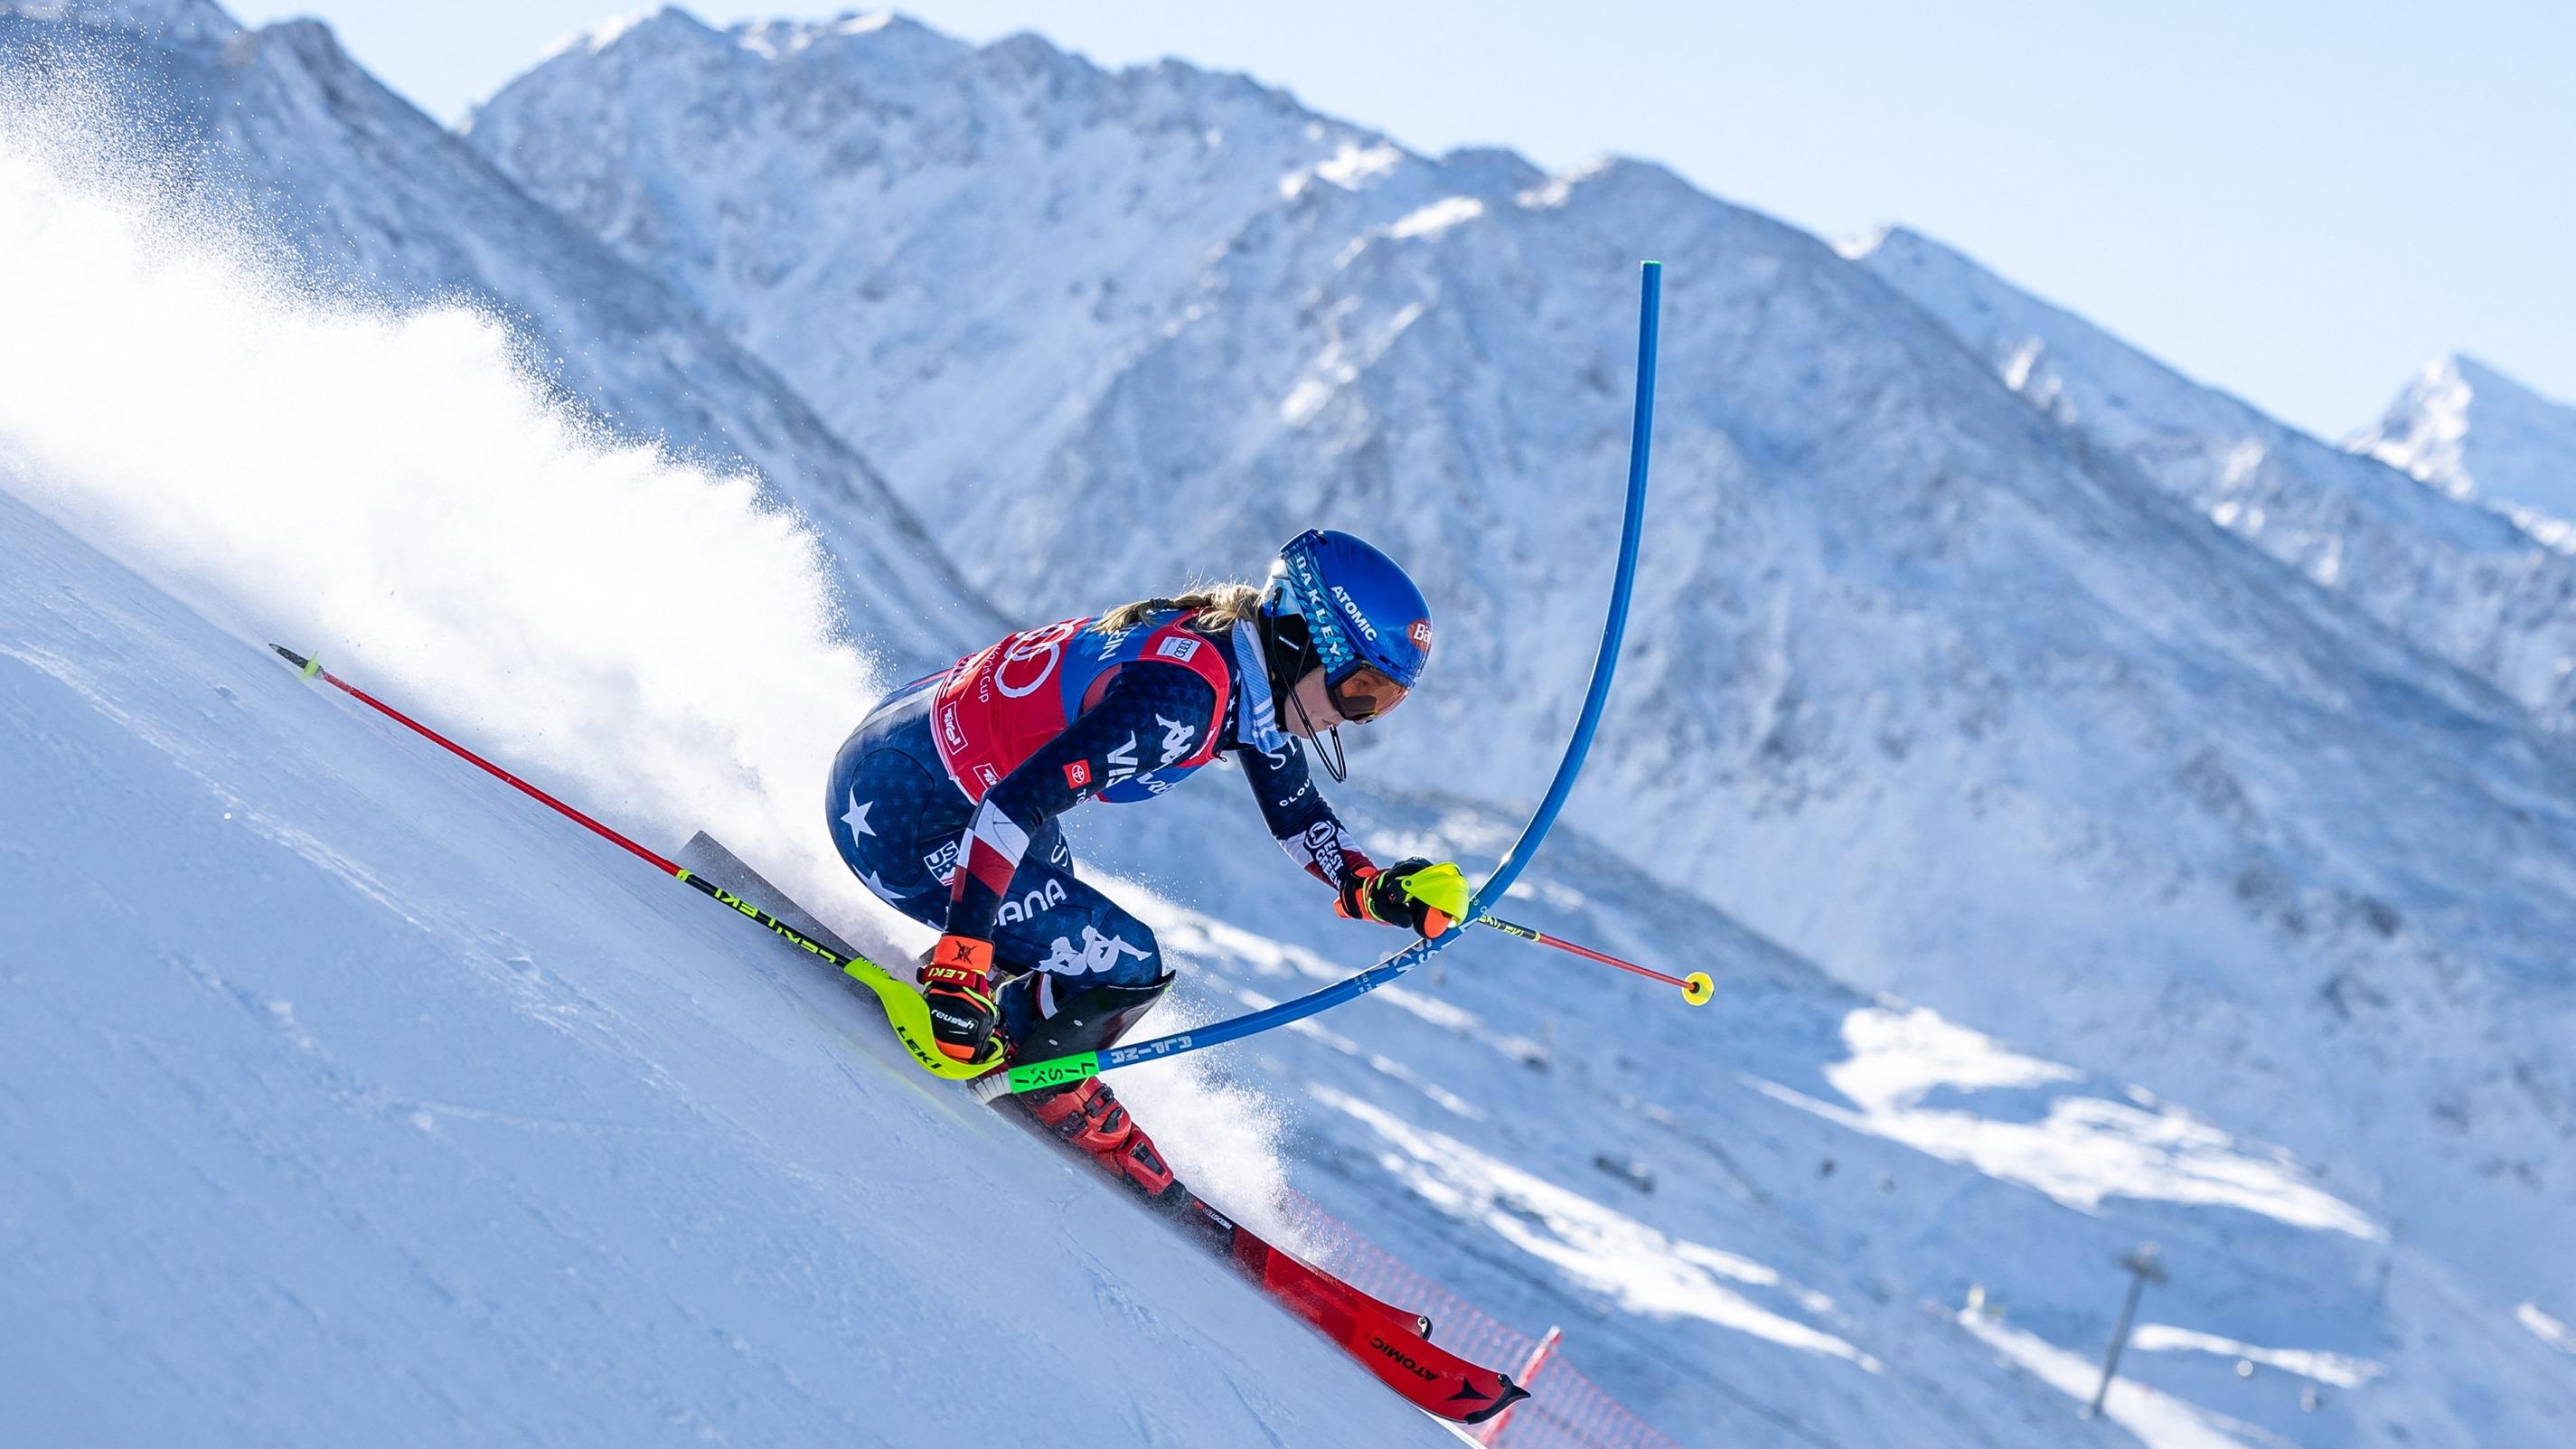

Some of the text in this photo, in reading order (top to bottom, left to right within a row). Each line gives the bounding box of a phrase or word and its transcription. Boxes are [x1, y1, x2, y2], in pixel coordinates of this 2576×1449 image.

[1296, 555, 1341, 656] OAKLEY
[1330, 586, 1377, 642] ATOMIC
[977, 675, 992, 703] Cup
[1323, 840, 1344, 871] EASY
[927, 967, 968, 982] LEKI
[896, 1025, 943, 1070] LEKI
[1110, 1035, 1193, 1065] ALPINA
[1014, 1061, 1095, 1086] LISKI
[1369, 1337, 1440, 1382] ATOMIC
